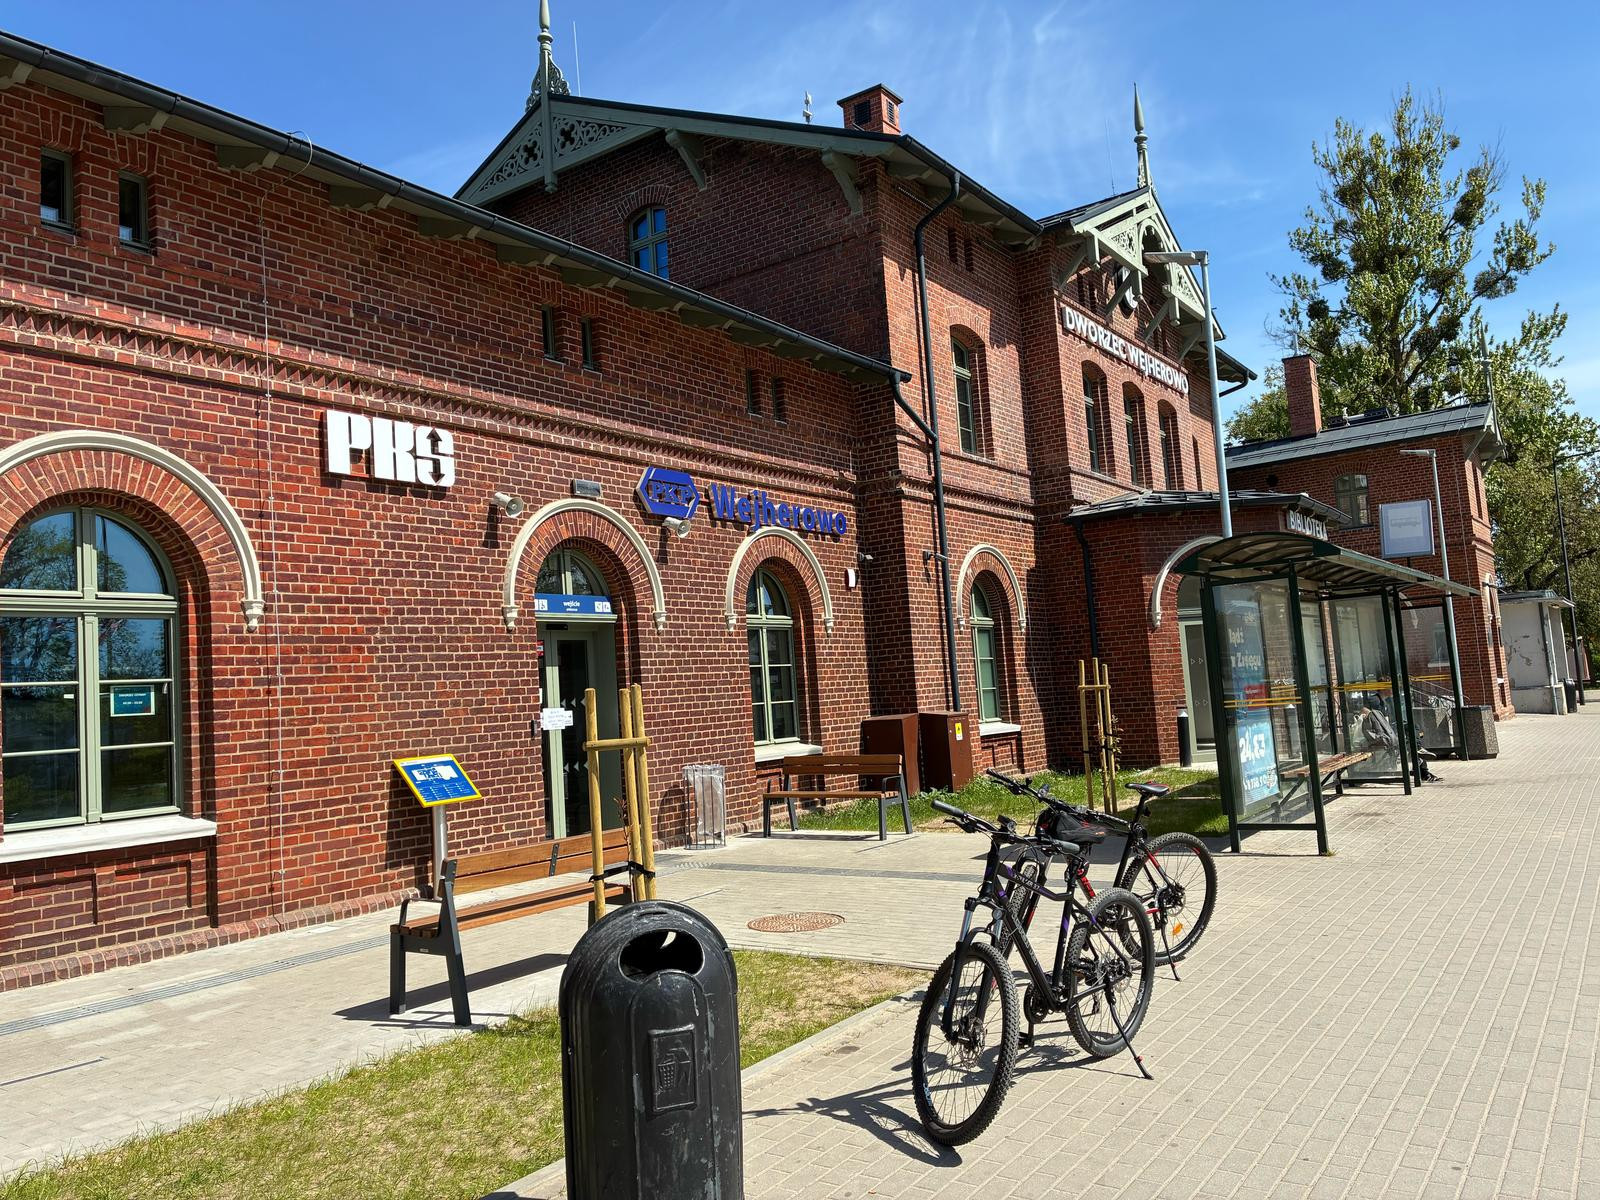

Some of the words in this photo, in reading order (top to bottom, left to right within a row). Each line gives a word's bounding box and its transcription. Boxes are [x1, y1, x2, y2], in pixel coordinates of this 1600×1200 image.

[1062, 304, 1127, 360] DWORZEC
[1128, 346, 1189, 394] WEJHEROWO
[325, 409, 456, 488] PKS
[651, 480, 697, 505] PKP
[708, 482, 847, 536] Wejherowo
[1287, 509, 1329, 542] BIBLIOTEKA
